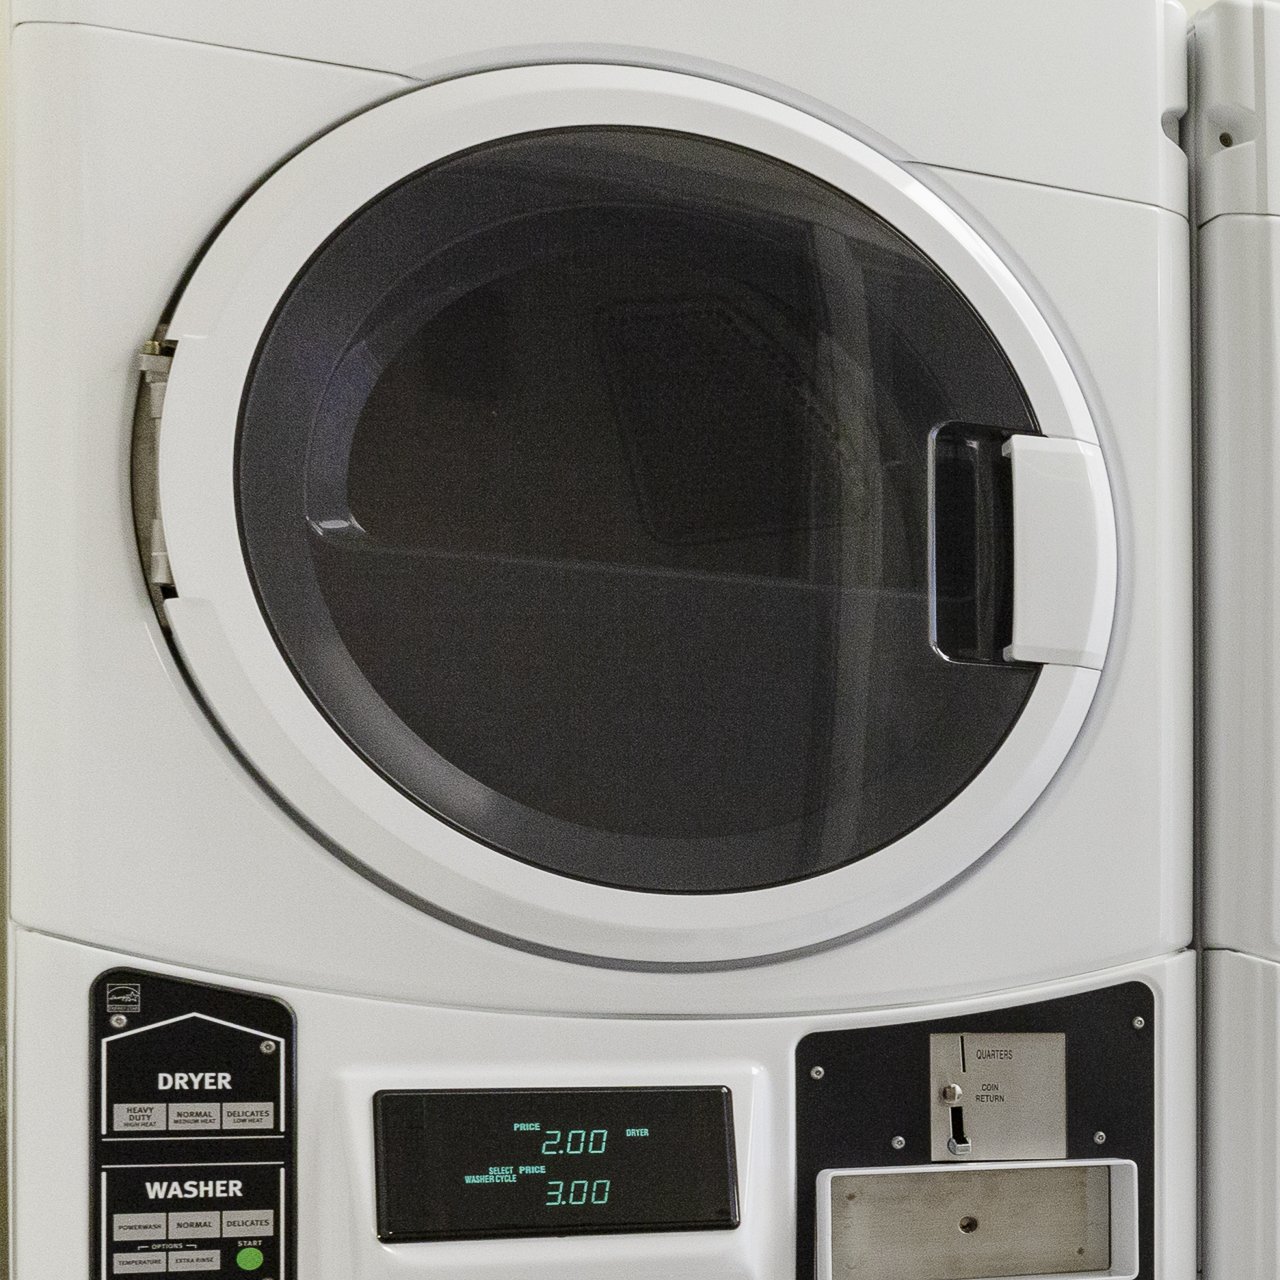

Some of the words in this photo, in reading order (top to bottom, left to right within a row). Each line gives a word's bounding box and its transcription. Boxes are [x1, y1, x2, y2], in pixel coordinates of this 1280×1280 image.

[976, 1050, 1013, 1060] QUARTERS
[157, 1072, 232, 1090] DRYER
[981, 1083, 999, 1091] COIN
[975, 1094, 1005, 1103] RETURN
[227, 1110, 270, 1118] DELICATES
[513, 1122, 541, 1131] PRICE
[626, 1128, 649, 1137] DRYER
[541, 1129, 608, 1155] 2.00
[488, 1166, 513, 1175] SELECT
[518, 1165, 546, 1174] PRICE
[464, 1174, 495, 1185] WASHER
[495, 1173, 517, 1183] CYCLE
[145, 1180, 243, 1199] WASHER
[546, 1180, 610, 1206] 3.00
[176, 1221, 213, 1229] NORMAL
[226, 1219, 270, 1228] DELICATES
